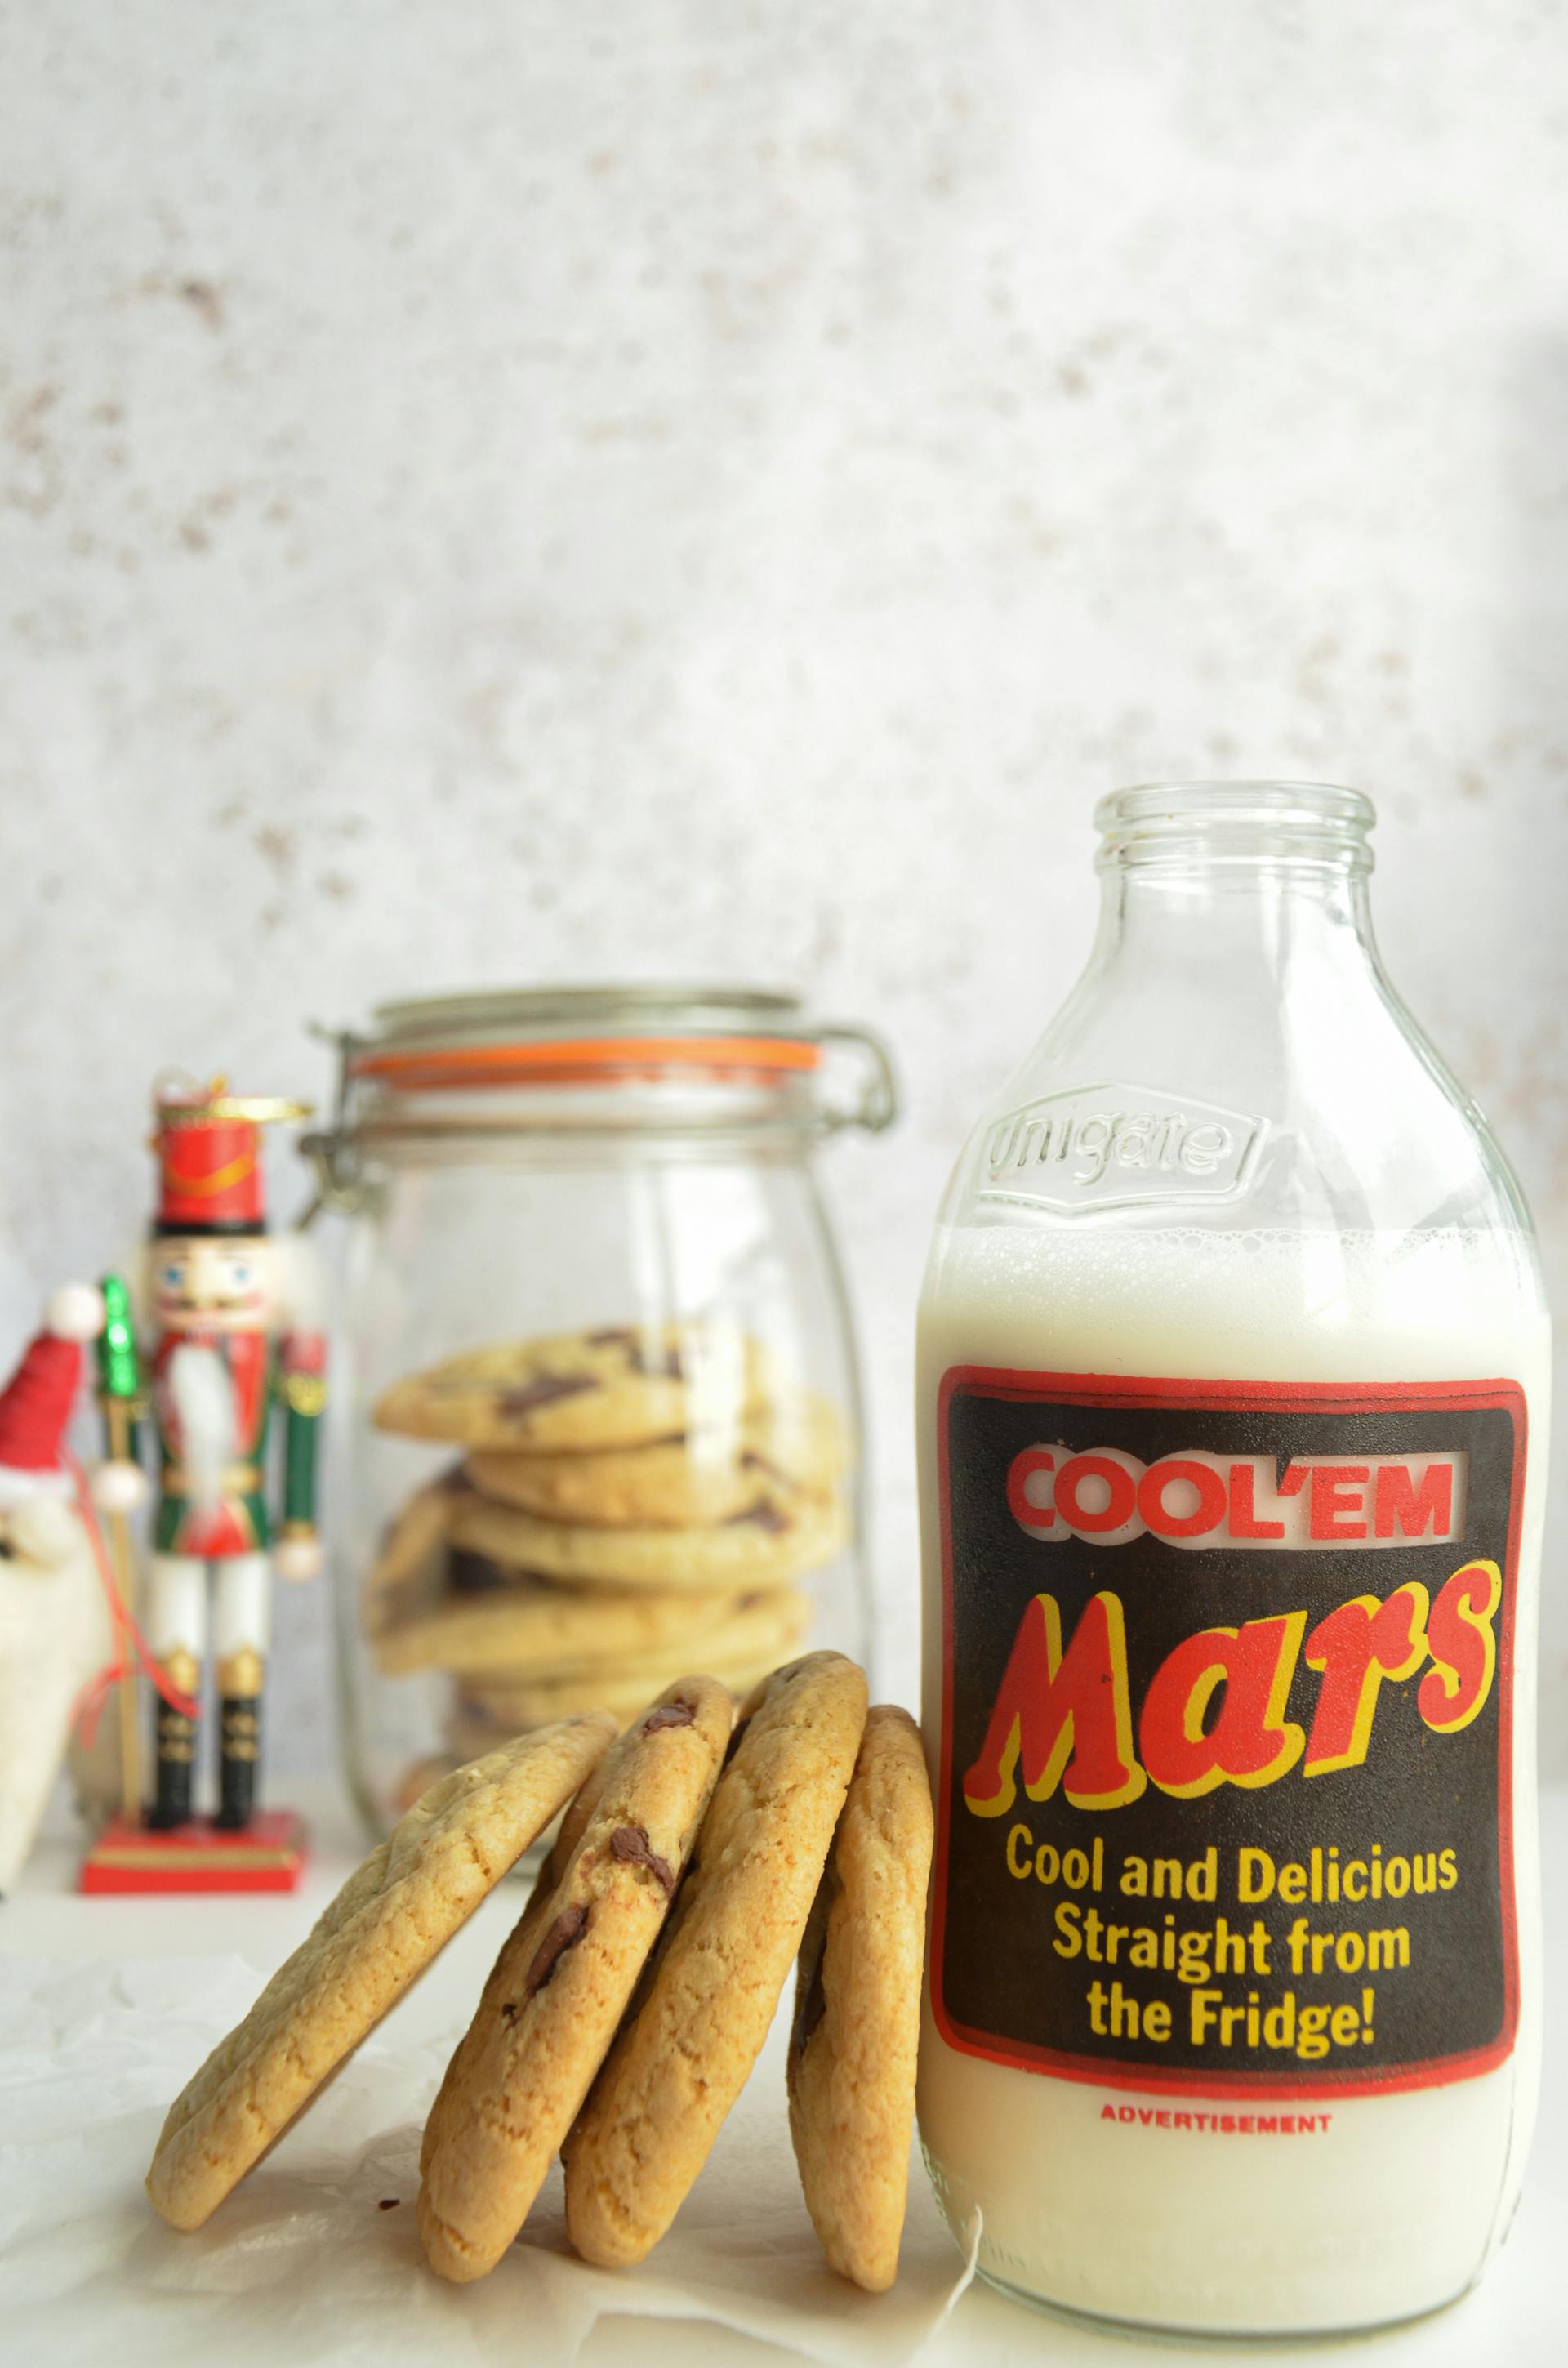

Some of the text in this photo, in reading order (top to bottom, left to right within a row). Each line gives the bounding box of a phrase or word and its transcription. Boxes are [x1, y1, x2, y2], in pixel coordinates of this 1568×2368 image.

[1006, 1450, 1454, 1541] COOL'EM
[962, 1558, 1503, 1819] Mars
[1006, 1824, 1459, 1904] Cool and Delicious
[1053, 1902, 1411, 1983] Straight from
[1087, 1981, 1375, 2060] the Fridge!
[1100, 2103, 1333, 2134] ADVERTISEMENT
